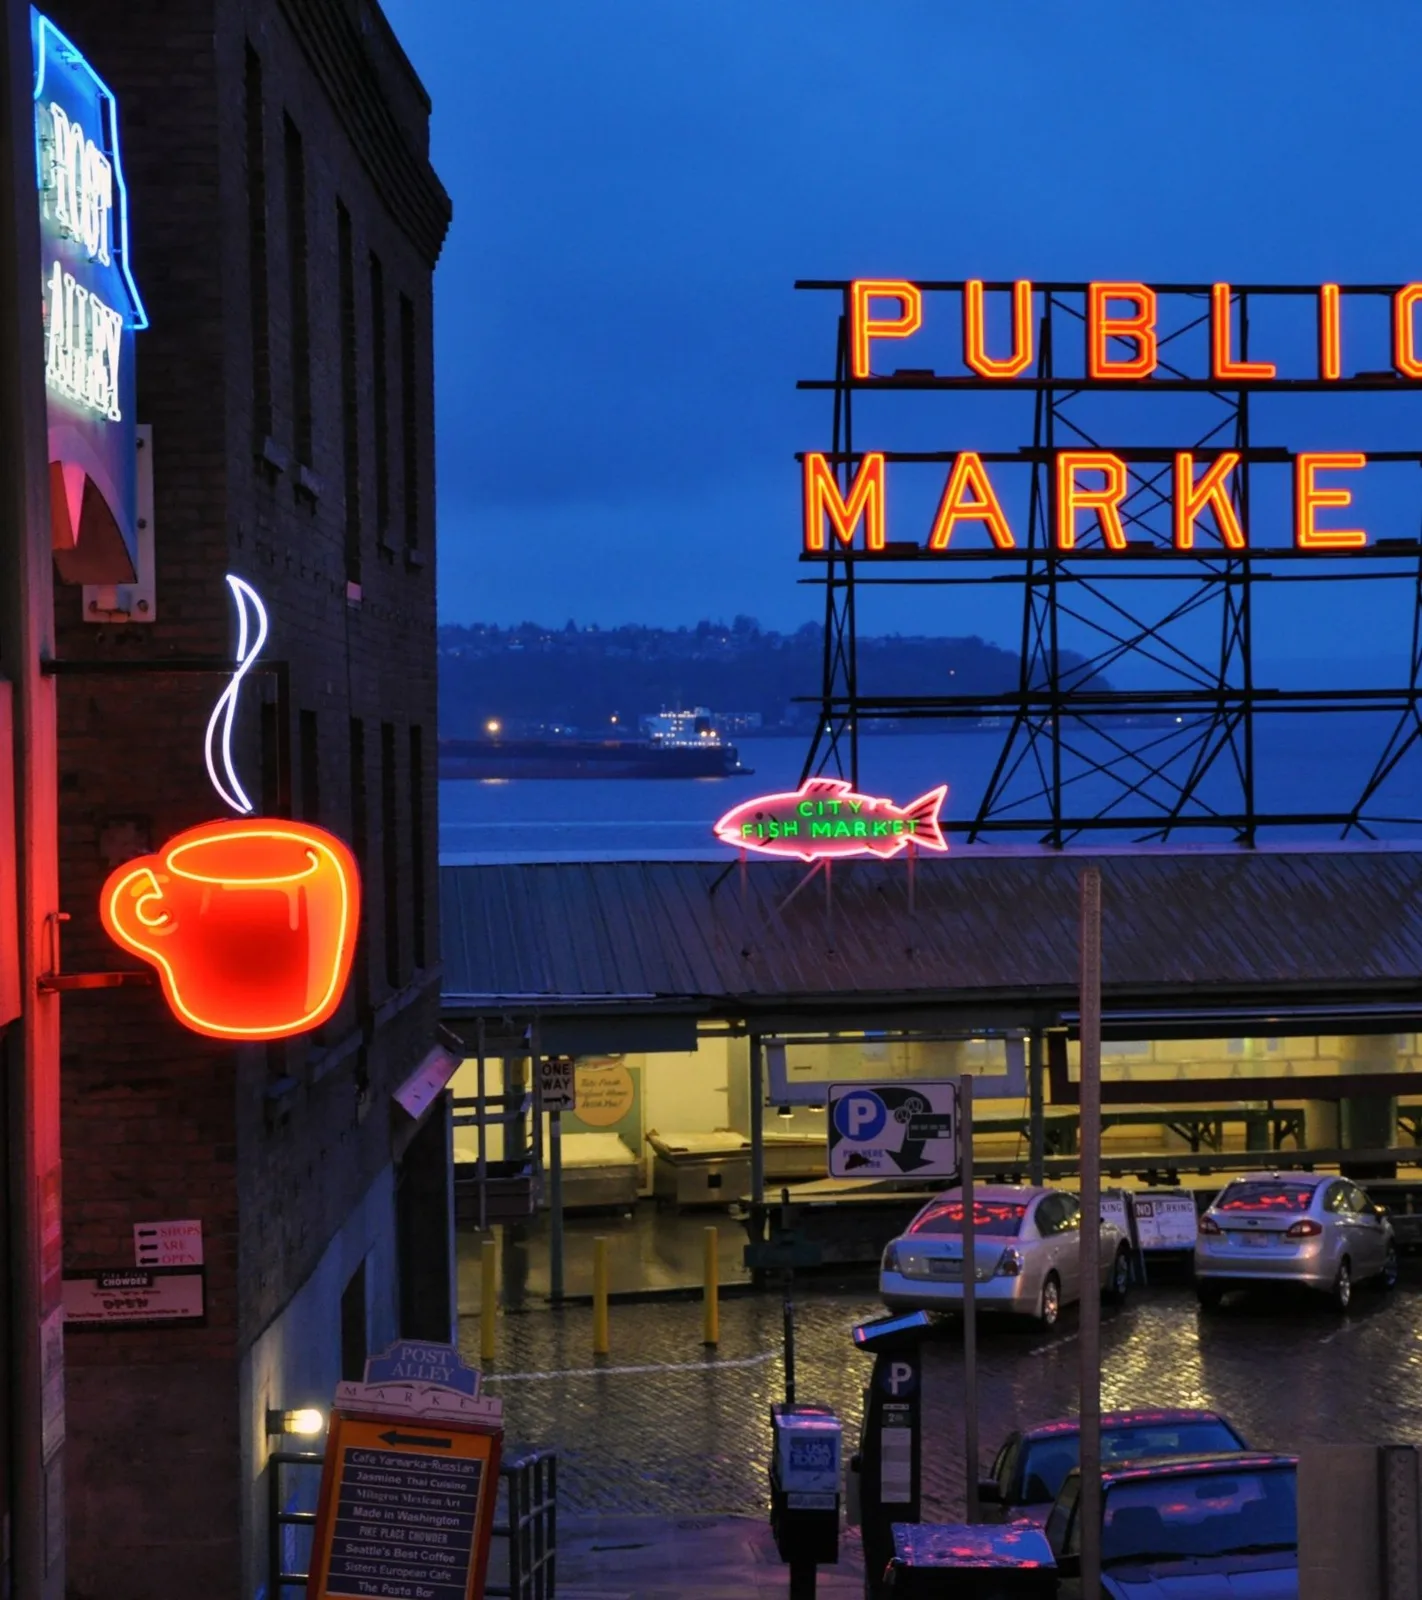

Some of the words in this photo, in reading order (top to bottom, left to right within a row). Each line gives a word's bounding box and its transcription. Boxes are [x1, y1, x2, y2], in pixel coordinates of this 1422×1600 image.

[50, 102, 112, 267] POST
[46, 261, 123, 422] ALLEY
[805, 452, 1367, 550] MARKE
[798, 800, 863, 817] CITY
[741, 820, 799, 839] FISH
[811, 819, 920, 838] MARKET
[542, 1063, 571, 1076] ONE
[541, 1078, 571, 1090] WAY
[848, 1098, 877, 1137] P
[1101, 1202, 1123, 1213] KING
[1136, 1203, 1152, 1217] NO
[159, 1226, 200, 1238] SHOPS
[162, 1240, 187, 1252] ARE
[161, 1254, 196, 1264] OPEN
[102, 1277, 148, 1287] CHOWDER
[102, 1298, 149, 1310] OPEN
[400, 1345, 452, 1366] POST
[390, 1362, 454, 1382] ALLEY
[344, 1385, 495, 1412] MARKET
[351, 1452, 376, 1464] Cafe
[356, 1471, 401, 1485] Jasmine
[407, 1476, 428, 1486] Thai
[430, 1479, 467, 1491] Cuisine
[402, 1493, 442, 1506] Mexican
[444, 1496, 461, 1507] Art
[352, 1506, 381, 1518] Made
[384, 1508, 395, 1519] in
[397, 1510, 460, 1526] Washington
[358, 1525, 378, 1537] PIKE
[380, 1527, 405, 1541] PLACE
[408, 1530, 448, 1544] CHOWDER
[345, 1543, 391, 1557] Seattle's
[393, 1548, 418, 1560] Best
[420, 1550, 456, 1563] Coffee
[344, 1561, 377, 1573] Sisters
[379, 1565, 427, 1579] European
[429, 1569, 452, 1581] Cafe
[358, 1581, 378, 1593] The
[381, 1583, 412, 1596] Pasta
[416, 1586, 435, 1598] Bar
